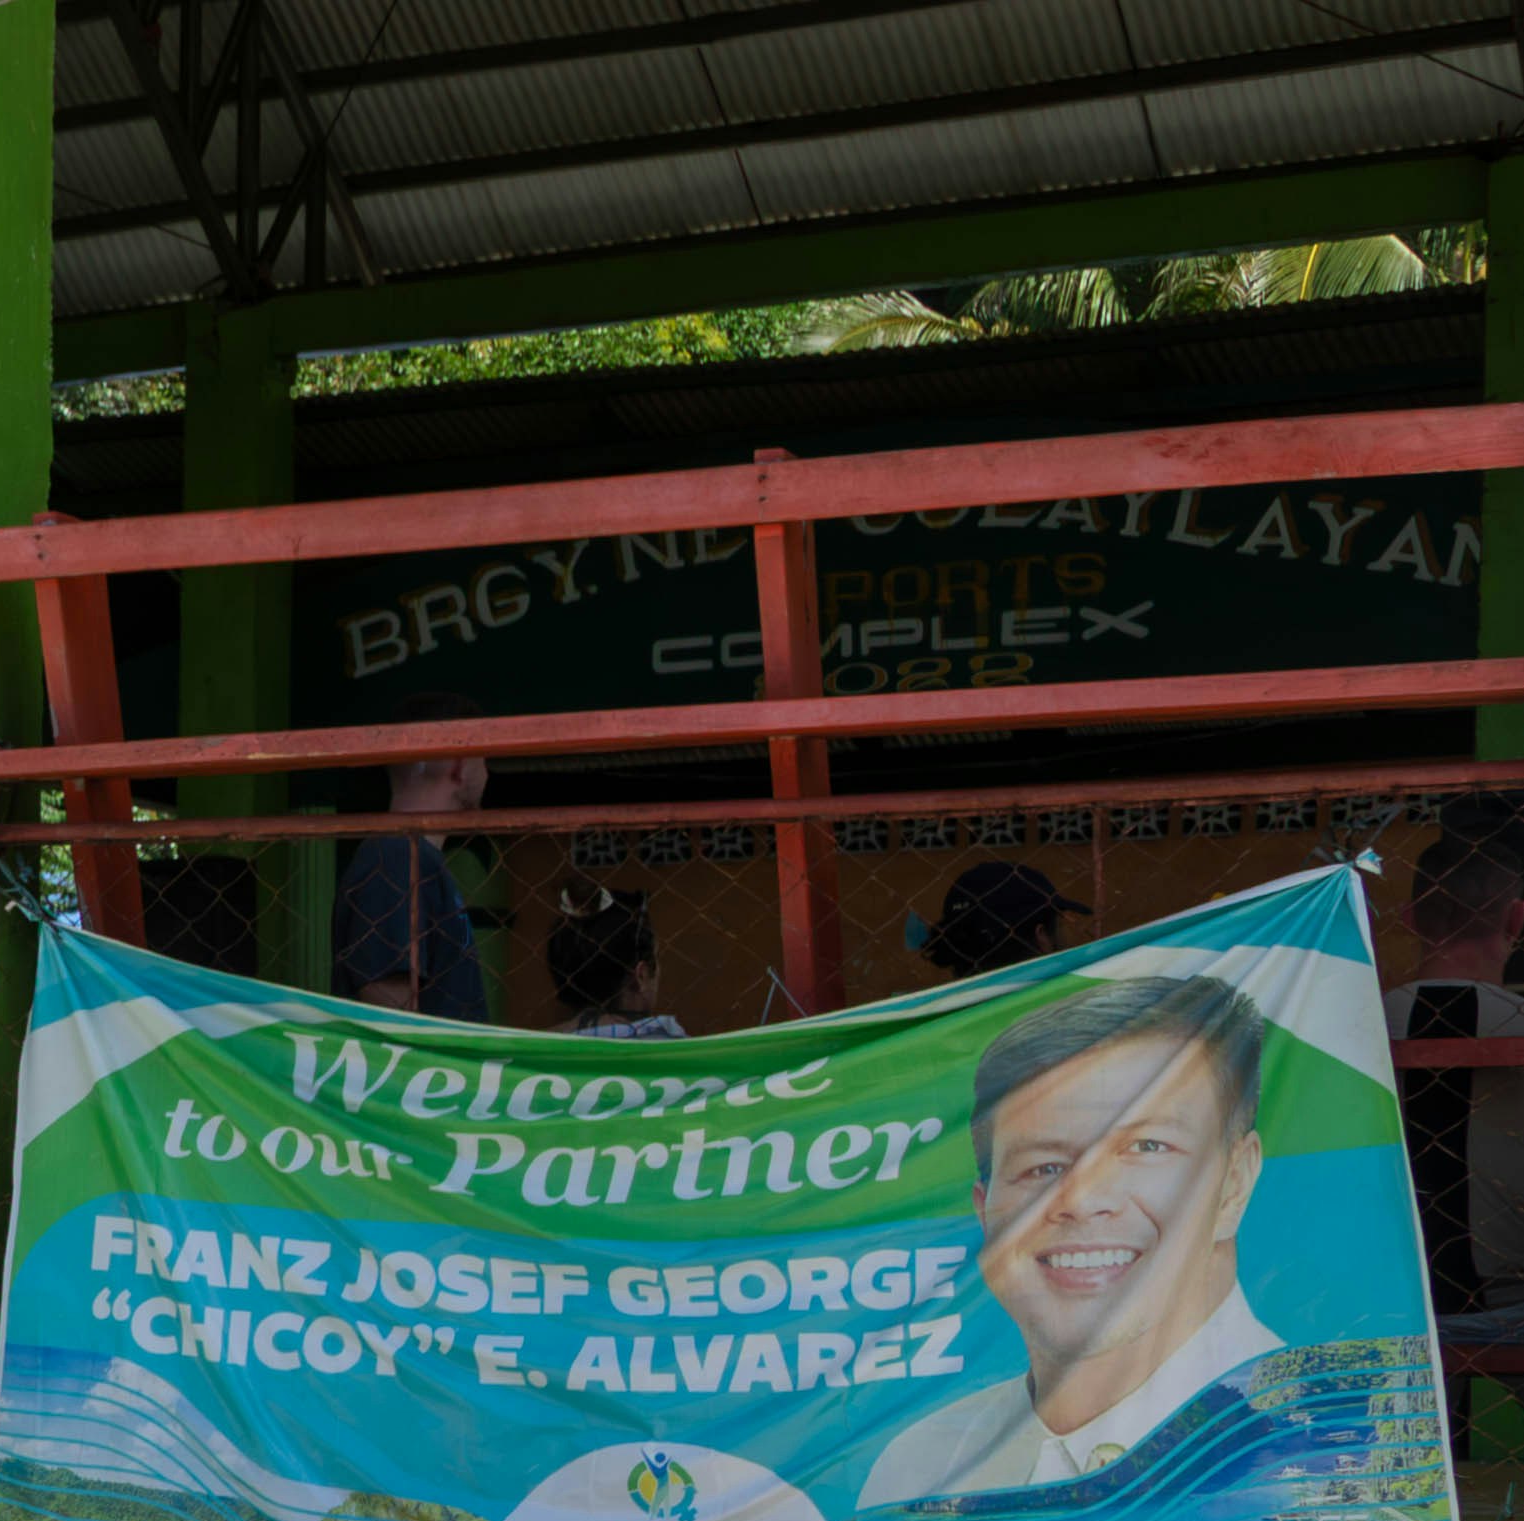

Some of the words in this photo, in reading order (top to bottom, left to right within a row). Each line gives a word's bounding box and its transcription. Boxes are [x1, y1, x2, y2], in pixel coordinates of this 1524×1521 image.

[335, 538, 600, 680] BRGY.
[613, 526, 749, 584] NE
[820, 551, 1109, 620] PORTS
[283, 1031, 833, 1121] Welcome
[163, 1098, 247, 1162] to
[260, 1125, 414, 1181] our
[430, 1116, 944, 1208] Partner
[91, 1214, 332, 1296] FRANZ
[341, 1247, 590, 1315] JOSEF
[607, 1245, 968, 1318] GEORGE
[92, 1286, 456, 1376] “CHICOY”
[473, 1334, 548, 1389] E.
[566, 1313, 965, 1393] ALVAREZ
